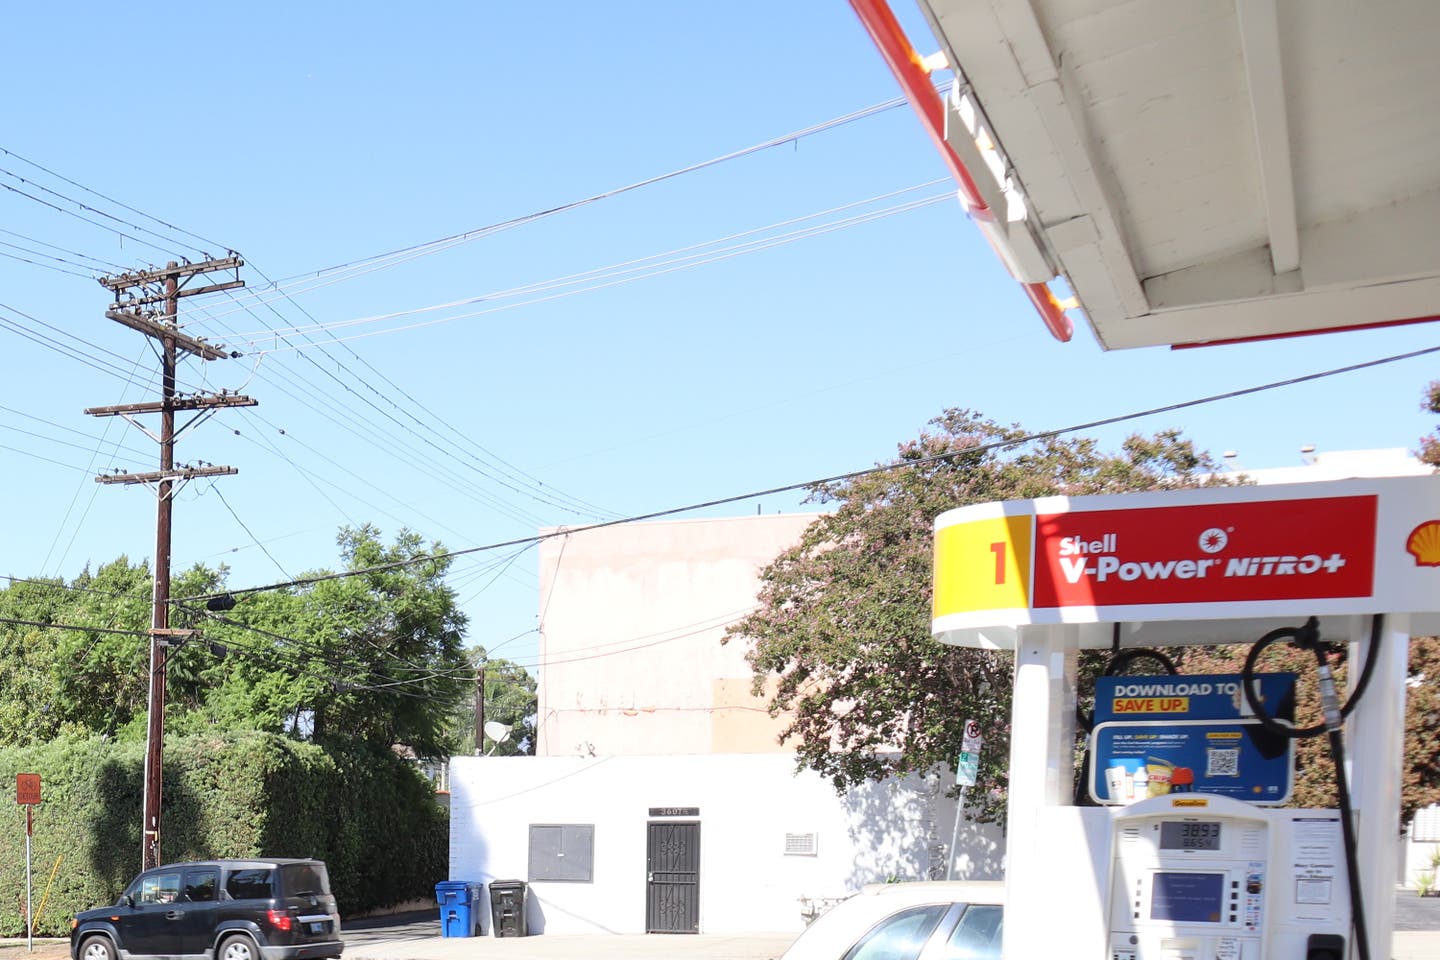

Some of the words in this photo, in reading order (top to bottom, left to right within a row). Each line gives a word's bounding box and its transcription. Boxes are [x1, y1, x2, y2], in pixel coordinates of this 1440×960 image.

[1059, 533, 1117, 557] Shell
[990, 541, 1007, 585] 1
[1059, 556, 1213, 584] V-Power
[1114, 683, 1212, 697] DOWNLOAD
[1216, 682, 1238, 695] TO
[1115, 699, 1154, 712] SAVE
[1160, 698, 1187, 712] UP.
